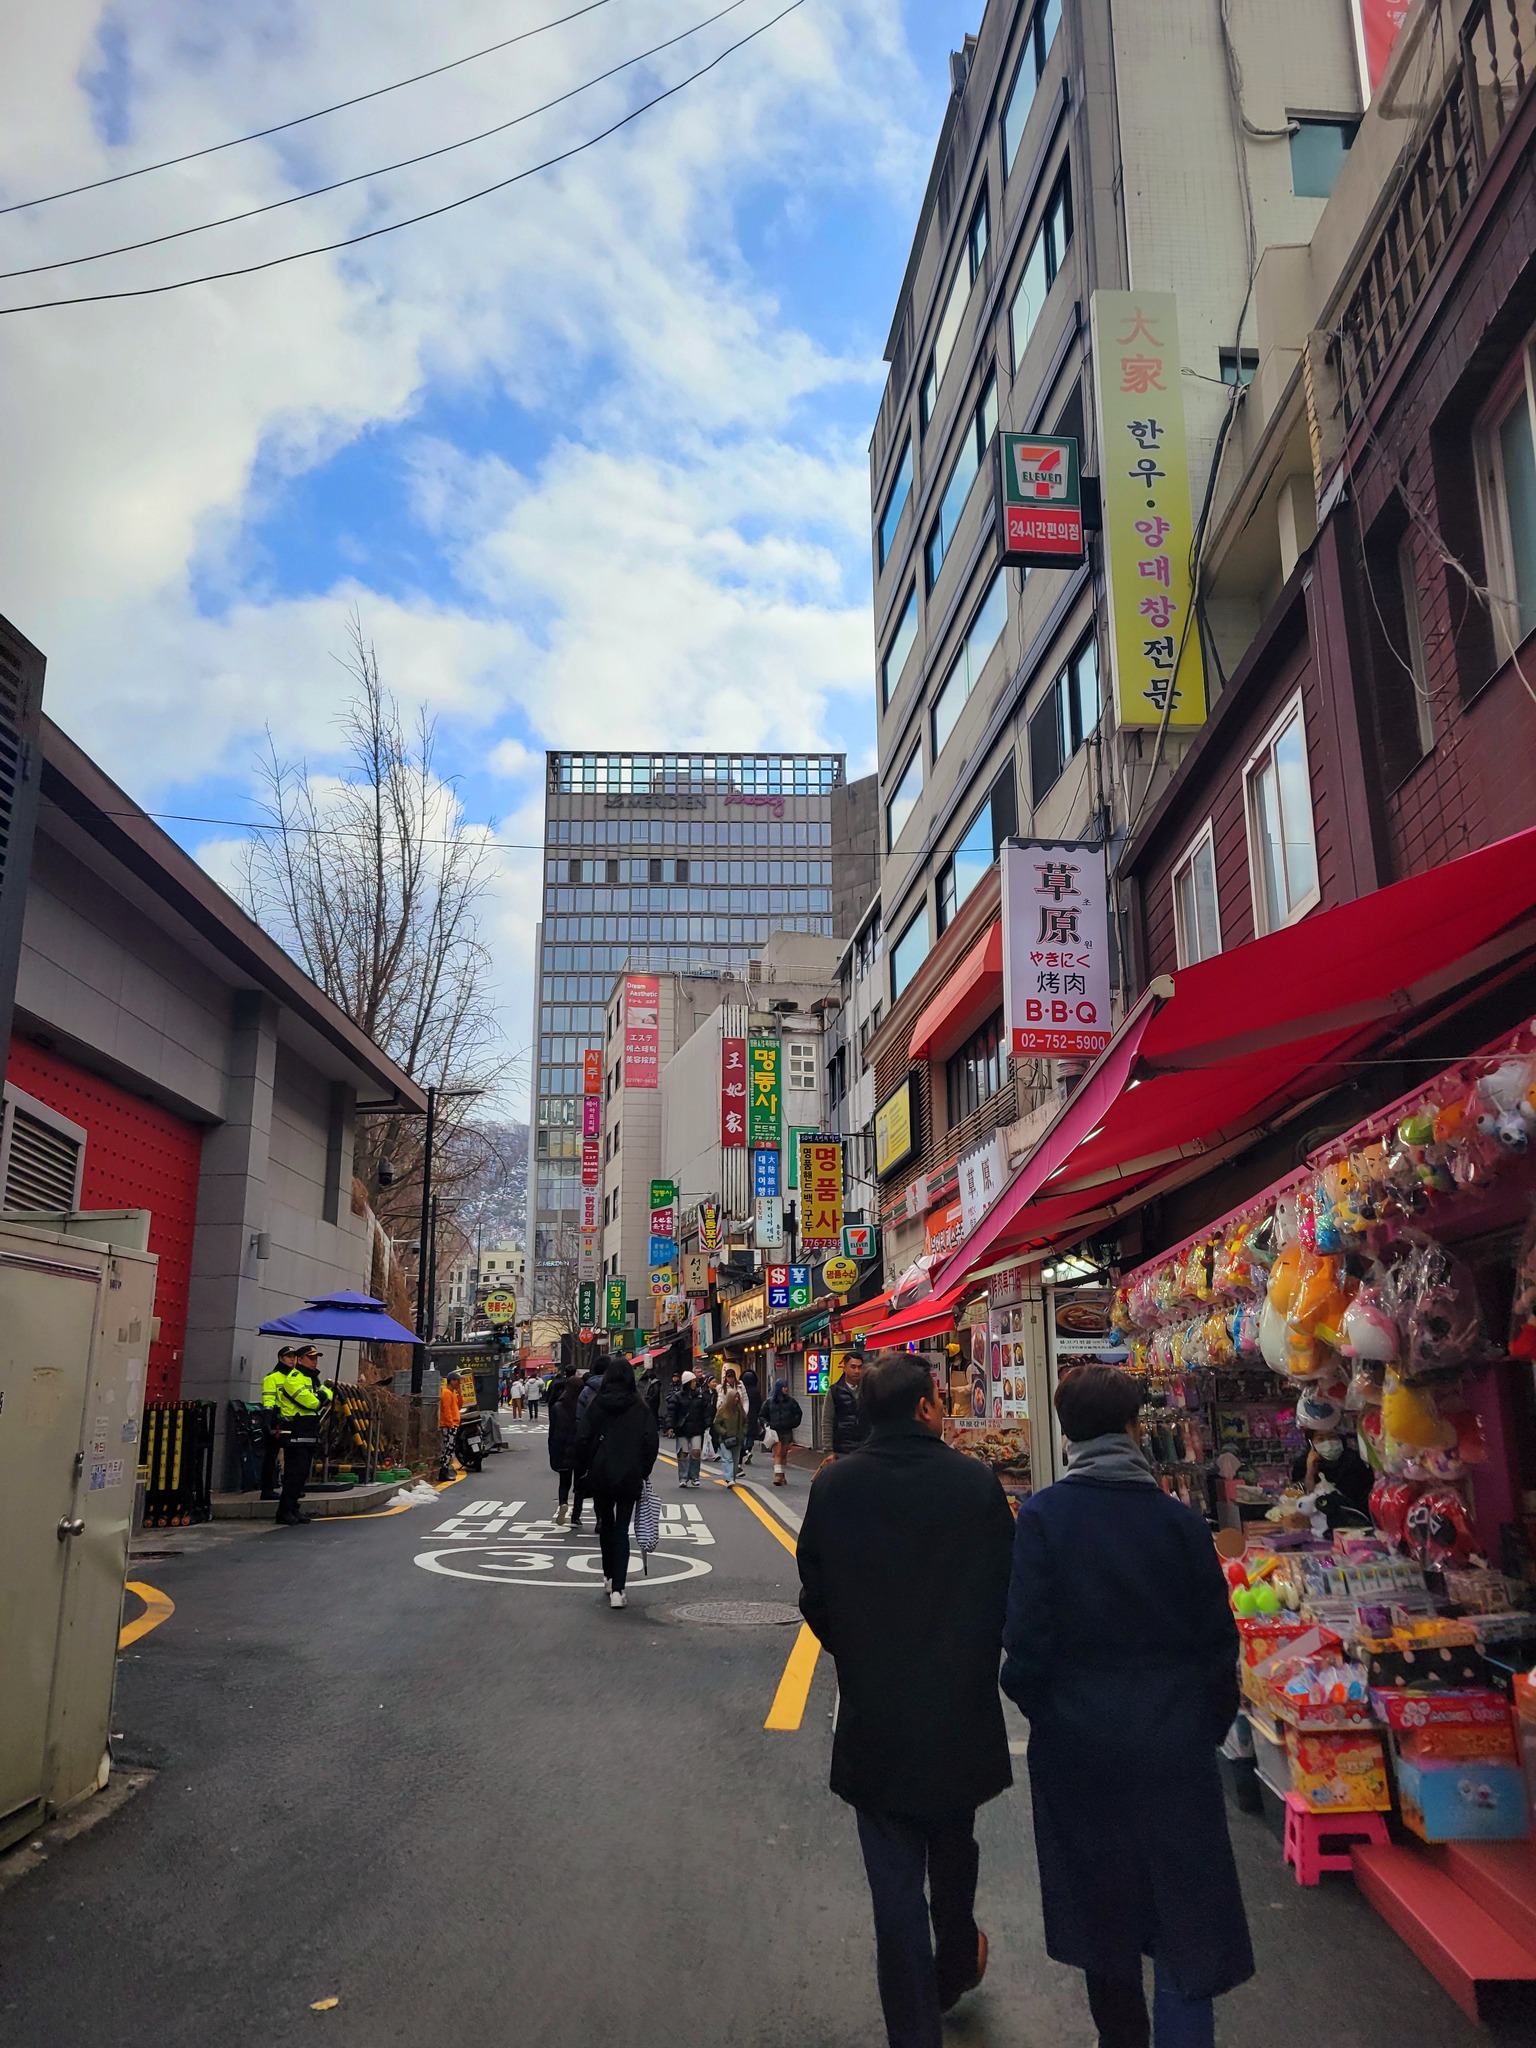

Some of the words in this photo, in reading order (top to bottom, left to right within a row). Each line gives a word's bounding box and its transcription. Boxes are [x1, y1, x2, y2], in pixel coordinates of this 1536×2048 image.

[1116, 305, 1167, 395] 大家
[1009, 519, 1080, 541] 24시간편의점
[1033, 860, 1082, 945] 草原
[1029, 950, 1091, 969] やきにく
[629, 990, 658, 998] Aesthetic
[1036, 970, 1086, 996] 烤肉
[1025, 998, 1098, 1025] B·B·Q
[626, 1045, 657, 1054] 에스테틱
[630, 1034, 653, 1042] エステ
[1020, 1032, 1106, 1051] 02-752-5900
[587, 1052, 599, 1079] 사주
[626, 1056, 657, 1065] 美容按摩
[722, 1051, 746, 1133] 王妃家
[754, 1049, 778, 1114] 명동사
[758, 1155, 766, 1197] 대륙여행
[803, 1147, 813, 1232] 명품핸드백·구두
[815, 1147, 840, 1233] 명품사
[706, 1209, 717, 1249] 명동포차
[690, 1258, 702, 1285] 성원
[771, 1267, 786, 1285] $
[791, 1268, 806, 1283] ¥
[826, 1270, 856, 1279] 명품수선
[487, 1302, 514, 1312] 명품수선
[610, 1286, 622, 1320] 명동사
[772, 1289, 787, 1305] 元
[791, 1288, 807, 1305] €
[808, 1355, 818, 1371] $
[820, 1355, 829, 1370] ¥
[808, 1375, 818, 1390] 元
[420, 1516, 716, 1545] 보호역
[478, 1551, 644, 1574] 30
